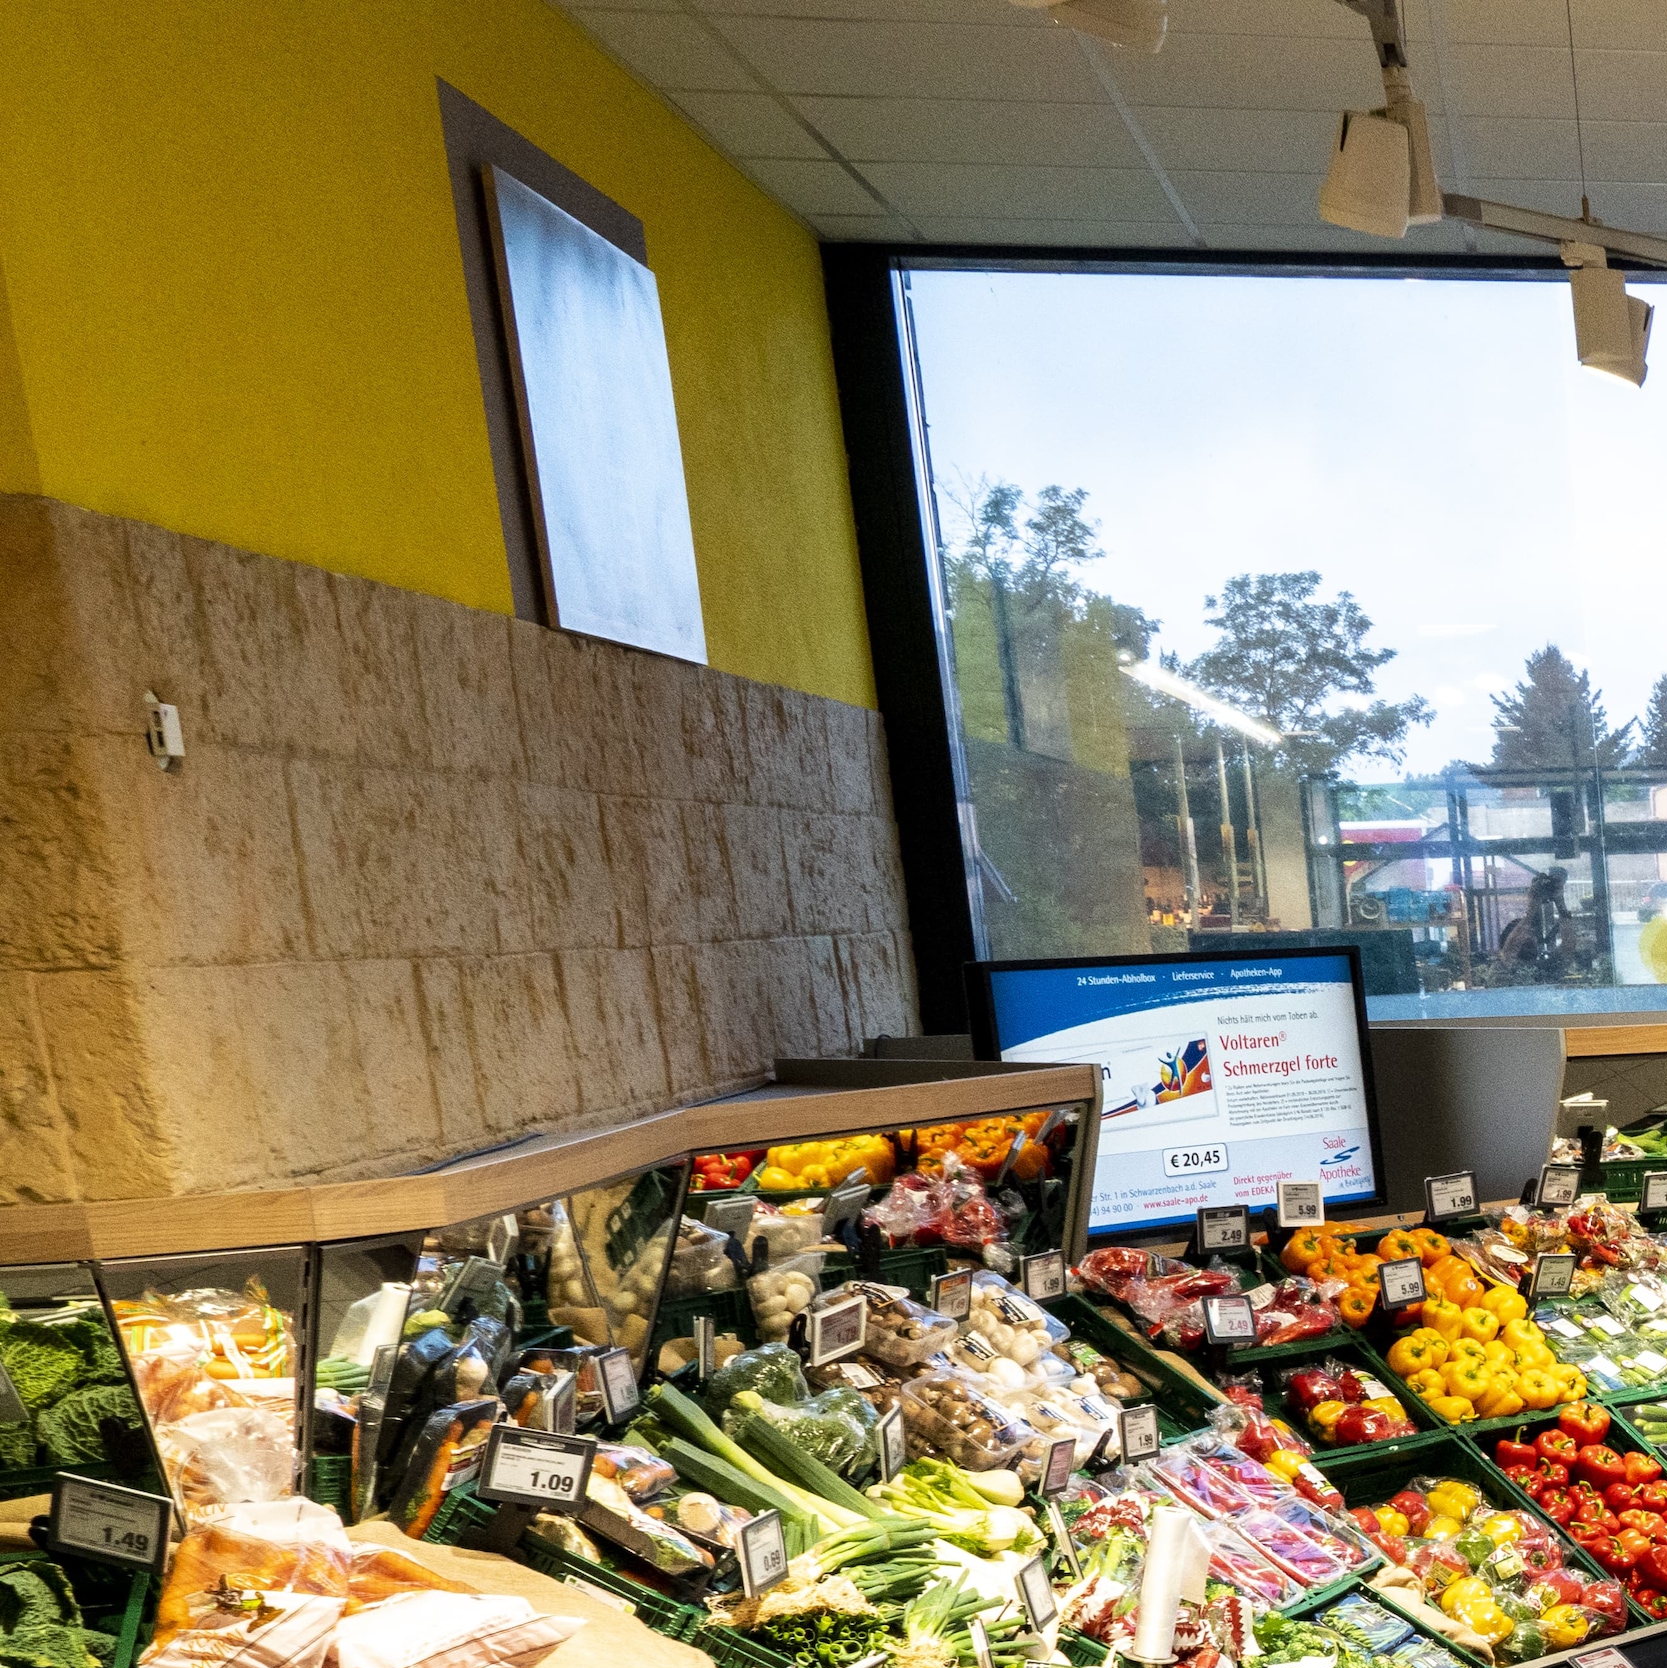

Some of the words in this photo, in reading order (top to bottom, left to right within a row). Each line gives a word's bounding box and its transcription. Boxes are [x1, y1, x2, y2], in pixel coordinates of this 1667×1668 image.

[1077, 977, 1087, 987] 24
[1088, 973, 1156, 986] Stunden-Abholbox
[1172, 970, 1214, 981] Lieferservice
[1230, 967, 1282, 979] Apotheken-App
[1217, 1015, 1239, 1025] Nichts
[1240, 1014, 1253, 1024] hält
[1255, 1013, 1271, 1023] mich
[1273, 1014, 1287, 1022] vom
[1288, 1012, 1308, 1021] Toben
[1309, 1011, 1319, 1019] ab.
[1223, 1058, 1302, 1078] Schmerzgel
[1306, 1053, 1338, 1070] forte
[1322, 1136, 1346, 1150] Saale
[1170, 1154, 1180, 1168] €
[1183, 1150, 1220, 1167] 20,45
[1233, 1175, 1255, 1185] Direkt
[1257, 1171, 1292, 1184] gegenüber
[1319, 1165, 1361, 1182] Apotheke
[1100, 1193, 1112, 1201] Str.
[1130, 1184, 1183, 1198] Schwarzenbach
[1199, 1180, 1216, 1189] Saale
[1235, 1190, 1249, 1198] vom
[1252, 1186, 1275, 1196] EDEKA
[1556, 1190, 1571, 1198] 1.99
[1102, 1205, 1111, 1214] 94
[1112, 1204, 1121, 1212] 90
[1123, 1203, 1133, 1211] 00
[1143, 1194, 1208, 1209] www.saale-apo.de
[1451, 1196, 1472, 1208] 1.99
[1299, 1205, 1316, 1215] 5.99
[1221, 1230, 1241, 1241] 2.49
[1043, 1277, 1060, 1291] 1.99
[1401, 1282, 1419, 1295] 5.99
[1551, 1277, 1566, 1286] 1.49
[1229, 1320, 1248, 1331] 2.49
[1138, 1433, 1153, 1447] 1.99
[530, 1471, 574, 1493] 1.09
[103, 1525, 149, 1551] 1.49
[763, 1553, 781, 1571] 0.69
